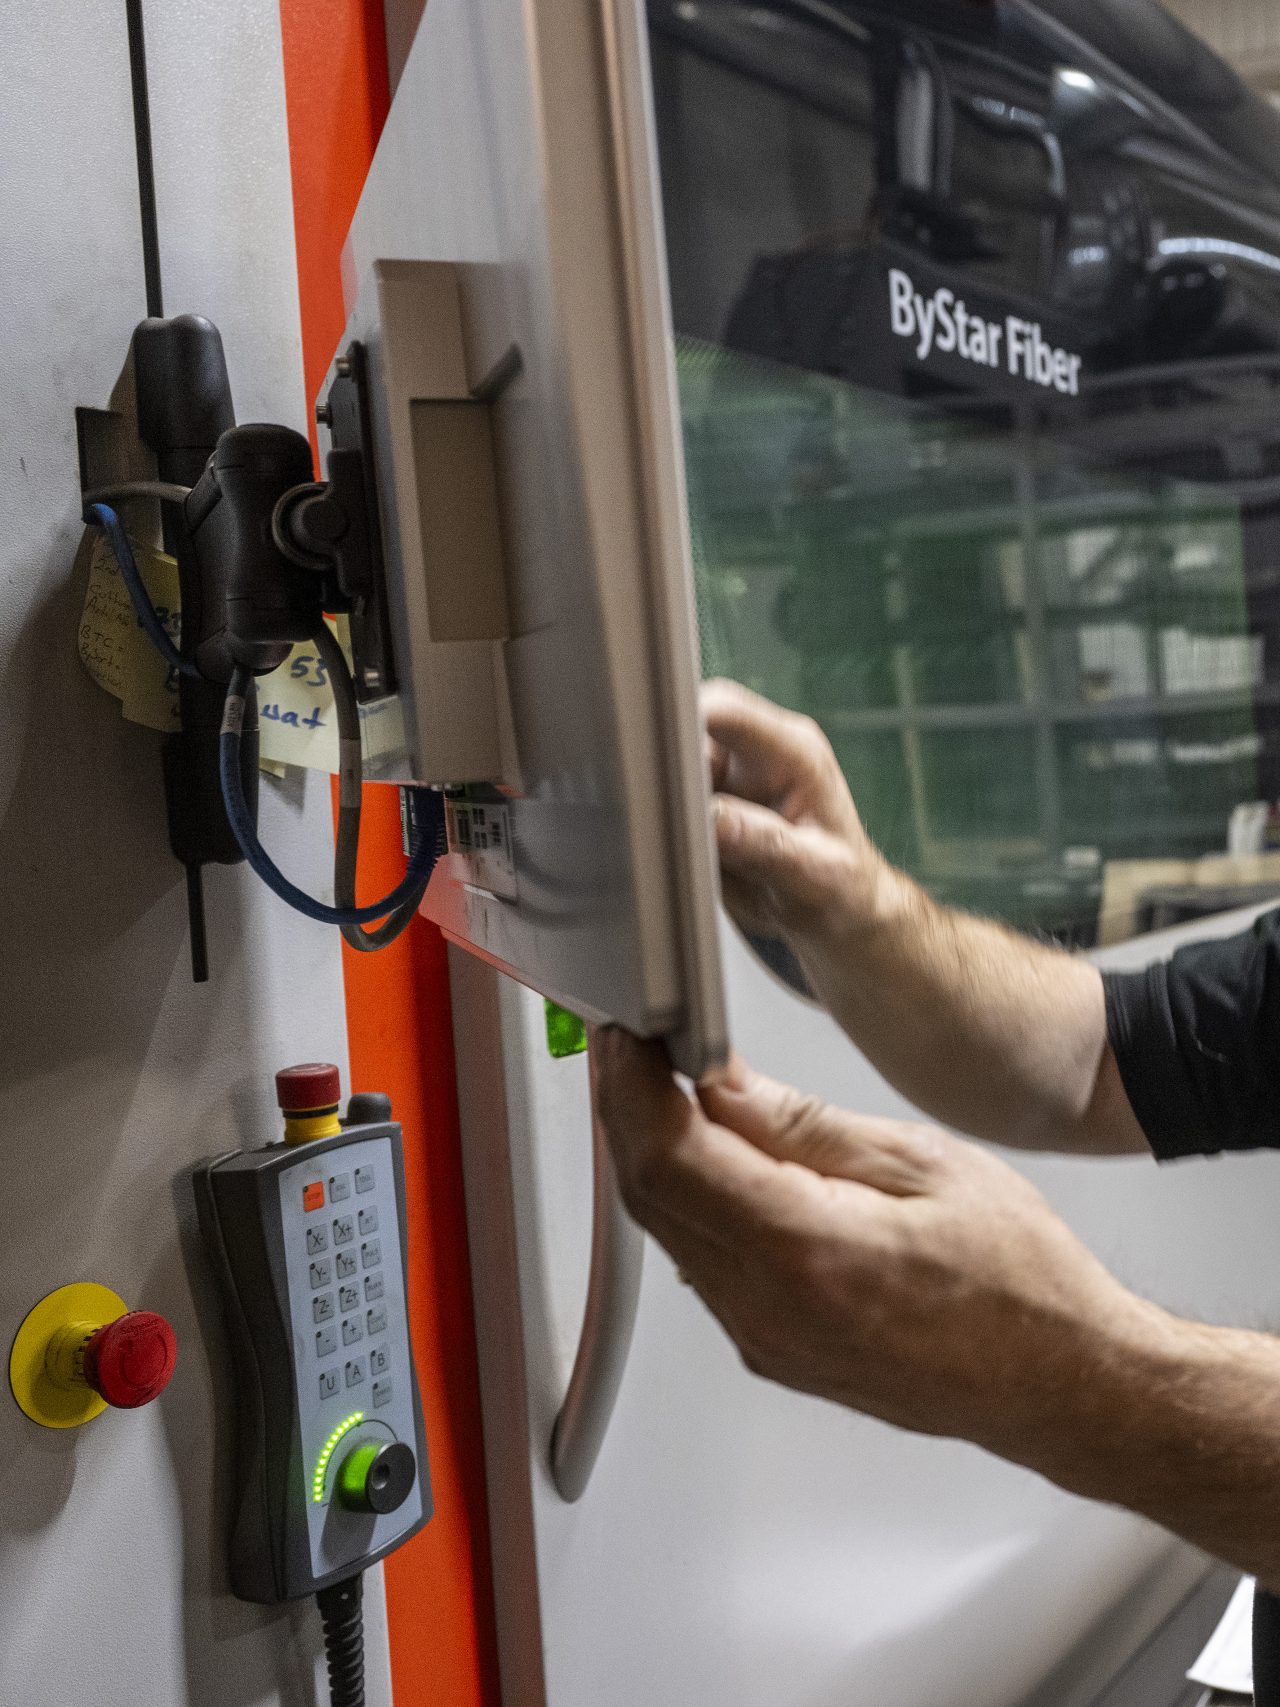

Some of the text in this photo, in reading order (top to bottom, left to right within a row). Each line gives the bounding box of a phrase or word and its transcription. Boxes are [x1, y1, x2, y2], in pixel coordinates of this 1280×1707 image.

[888, 267, 1082, 396] ByStar Fiber
[352, 1364, 361, 1378] A
[326, 1375, 335, 1391] U
